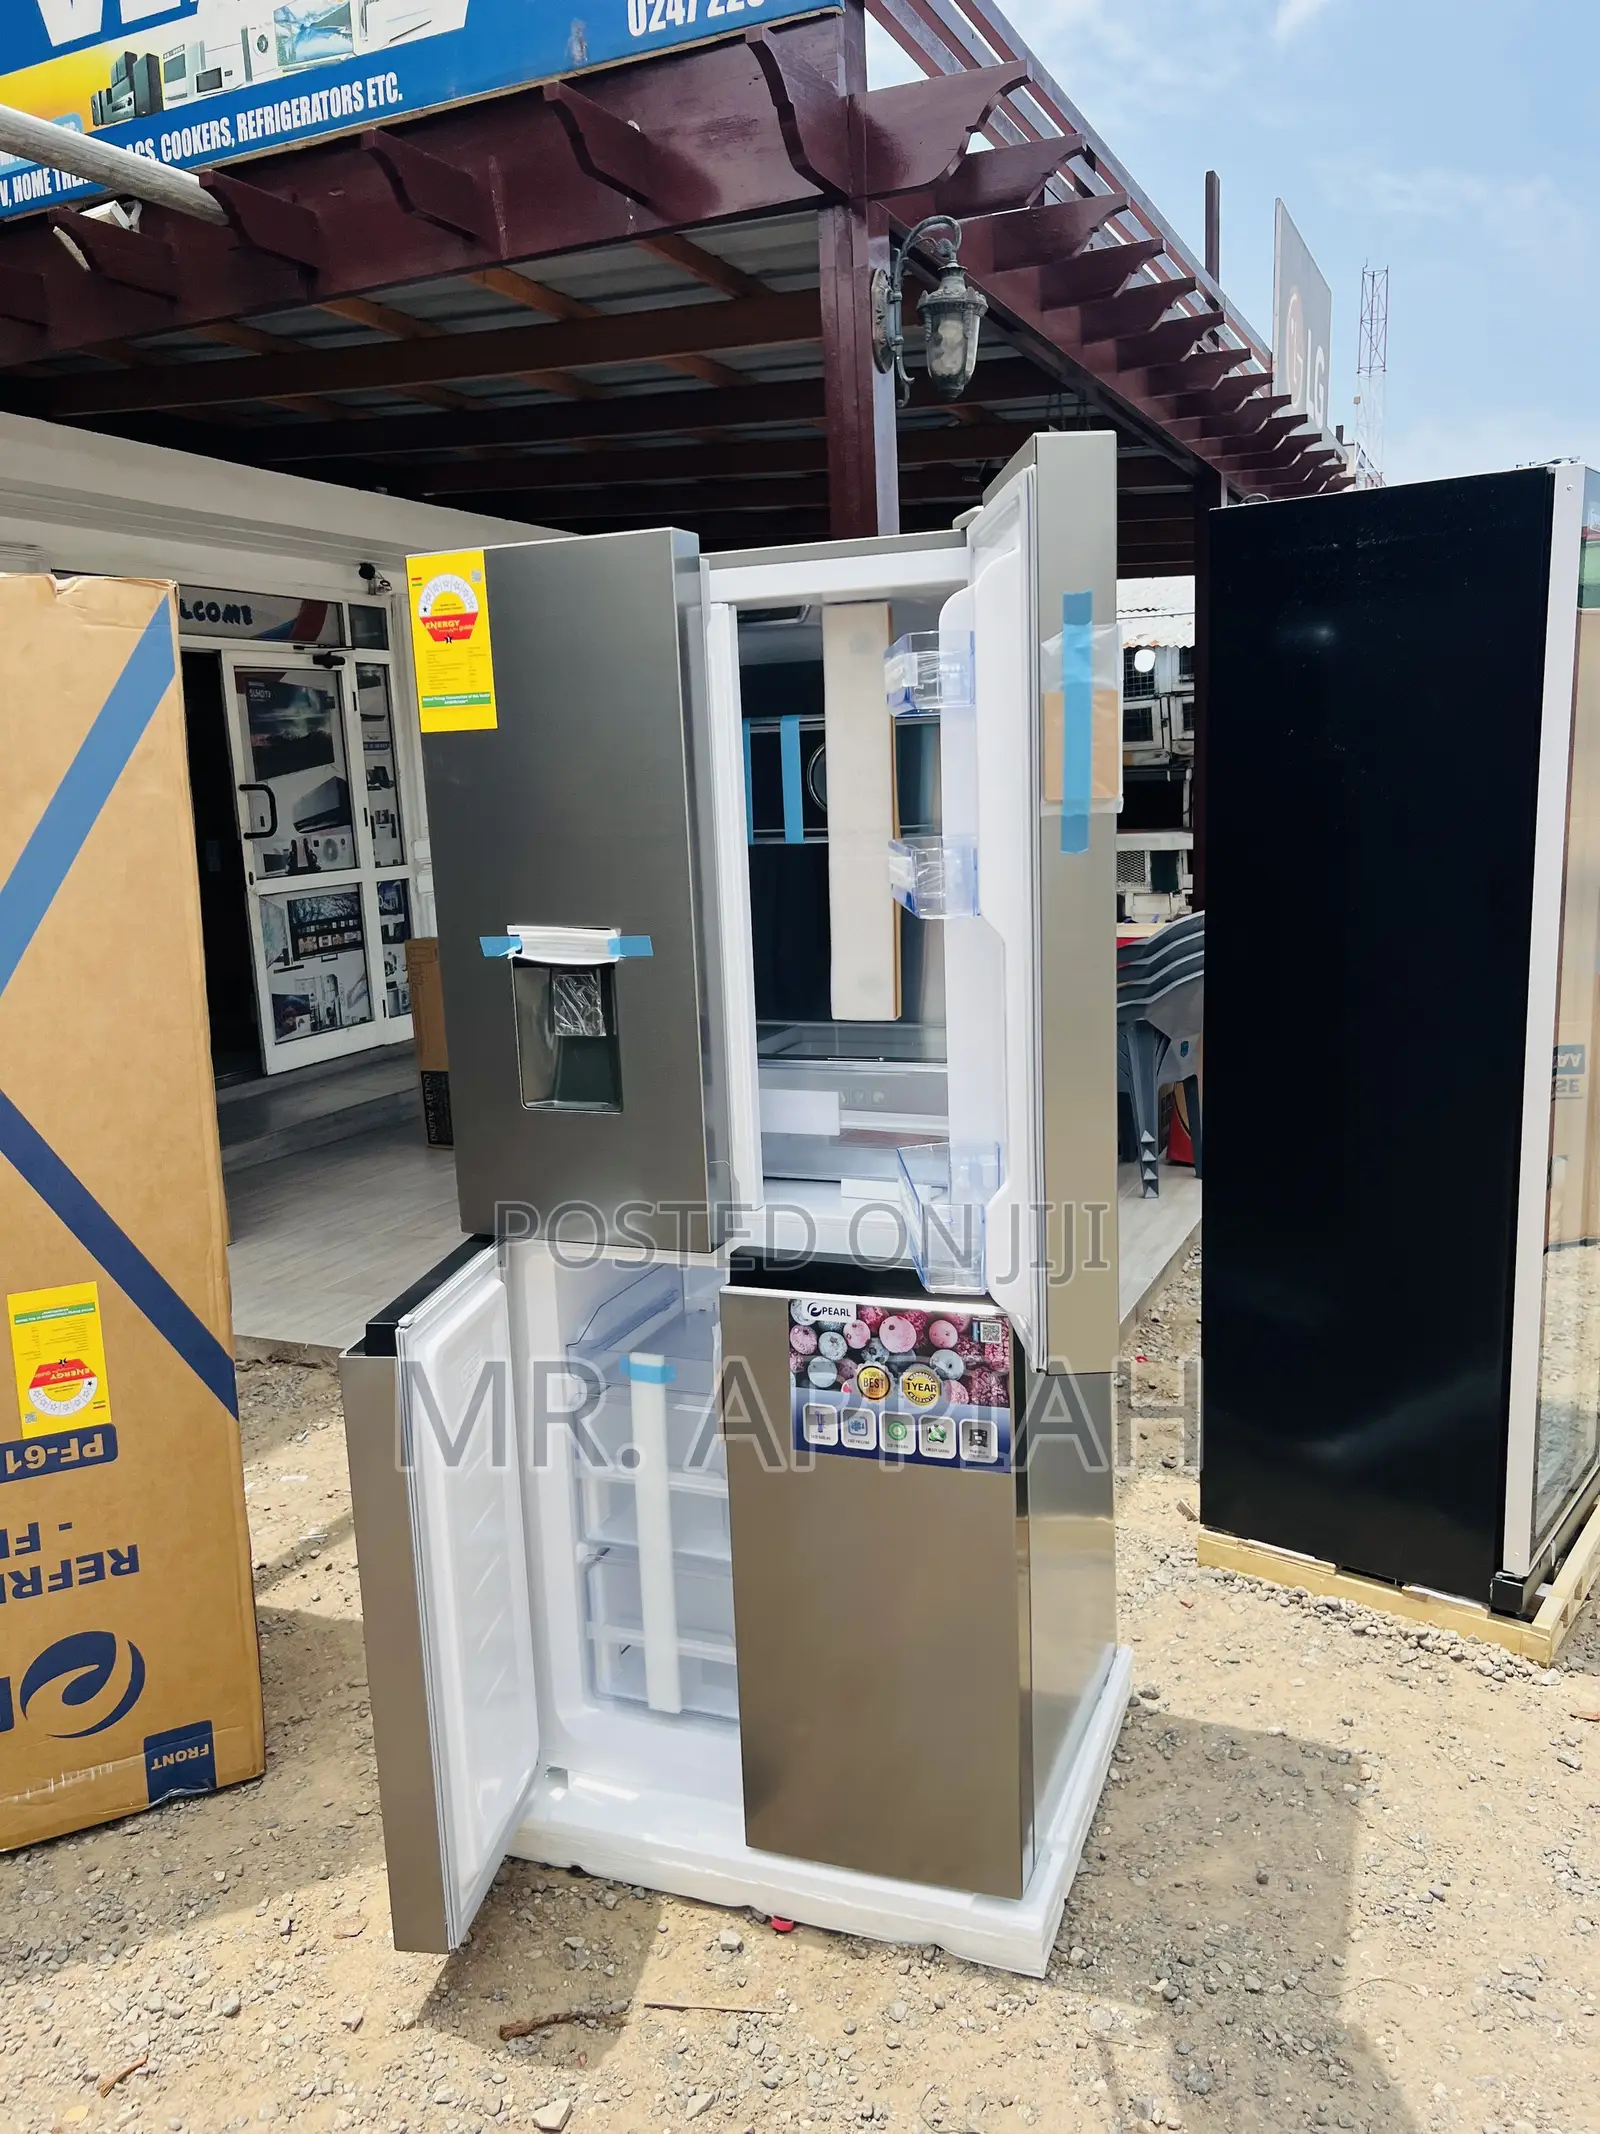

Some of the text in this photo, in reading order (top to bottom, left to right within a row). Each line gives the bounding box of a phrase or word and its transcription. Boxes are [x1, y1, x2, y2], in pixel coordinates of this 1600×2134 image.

[12, 167, 53, 203] HOME
[161, 119, 236, 163] COOKERS,
[236, 80, 363, 142] REFRIGERATORS
[366, 71, 404, 107] ETC.
[1305, 328, 1325, 430] LG
[425, 619, 461, 631] ENERGY
[821, 1306, 852, 1318] PEARL
[50, 1367, 90, 1381] ENERGY
[863, 1377, 884, 1389] BEST
[912, 1383, 937, 1393] YEAR
[151, 1743, 210, 1771] FRONT
